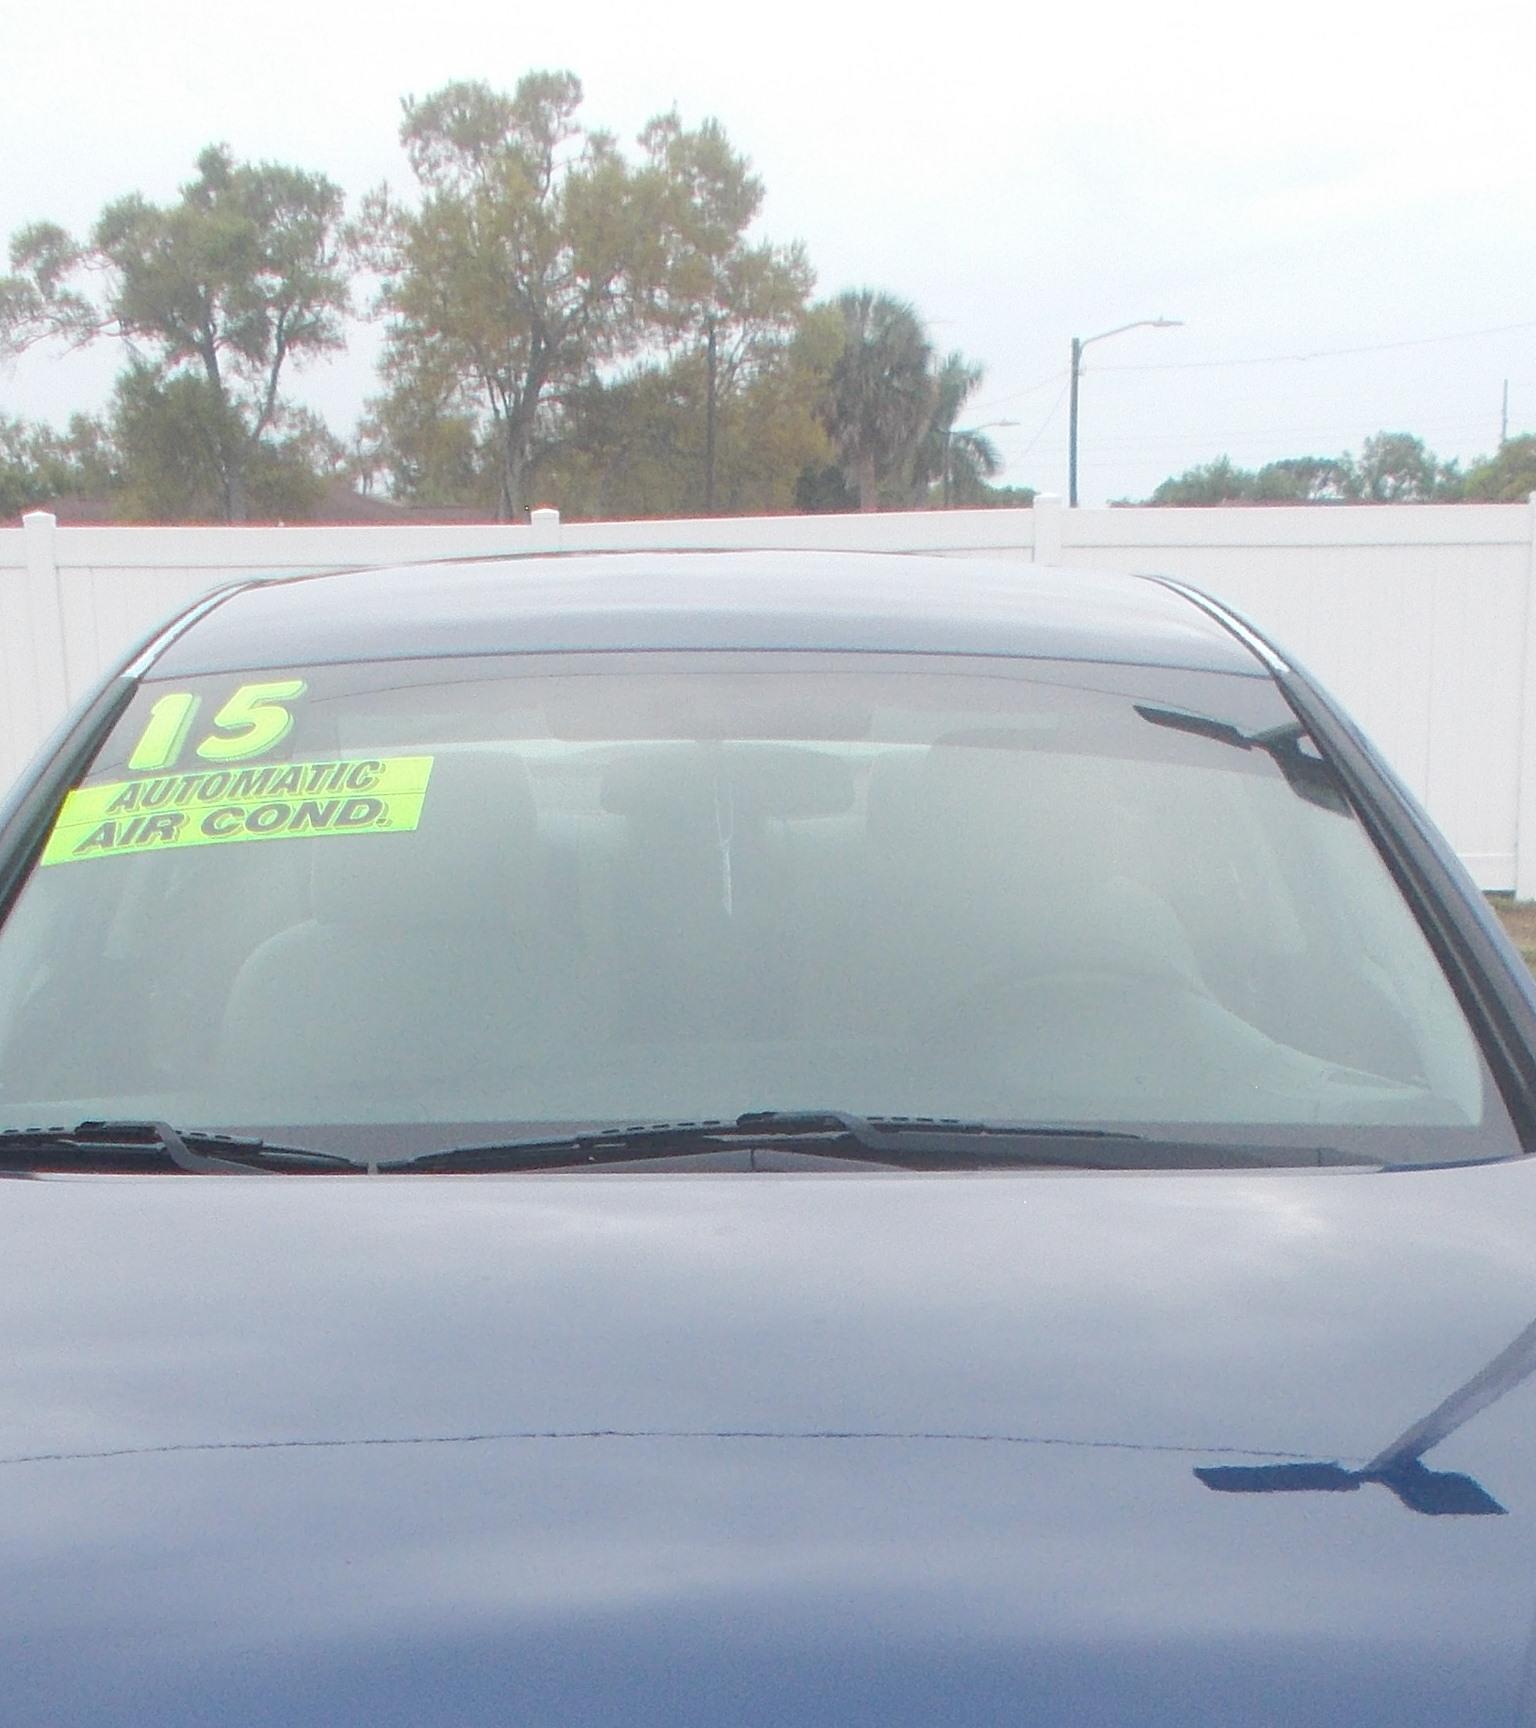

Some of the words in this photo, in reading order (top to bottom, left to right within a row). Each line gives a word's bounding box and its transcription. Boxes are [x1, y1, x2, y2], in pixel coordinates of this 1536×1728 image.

[128, 680, 308, 771] 15
[105, 760, 386, 815] AUTOMATIC
[71, 811, 191, 856] AIR
[200, 797, 393, 839] COND.
